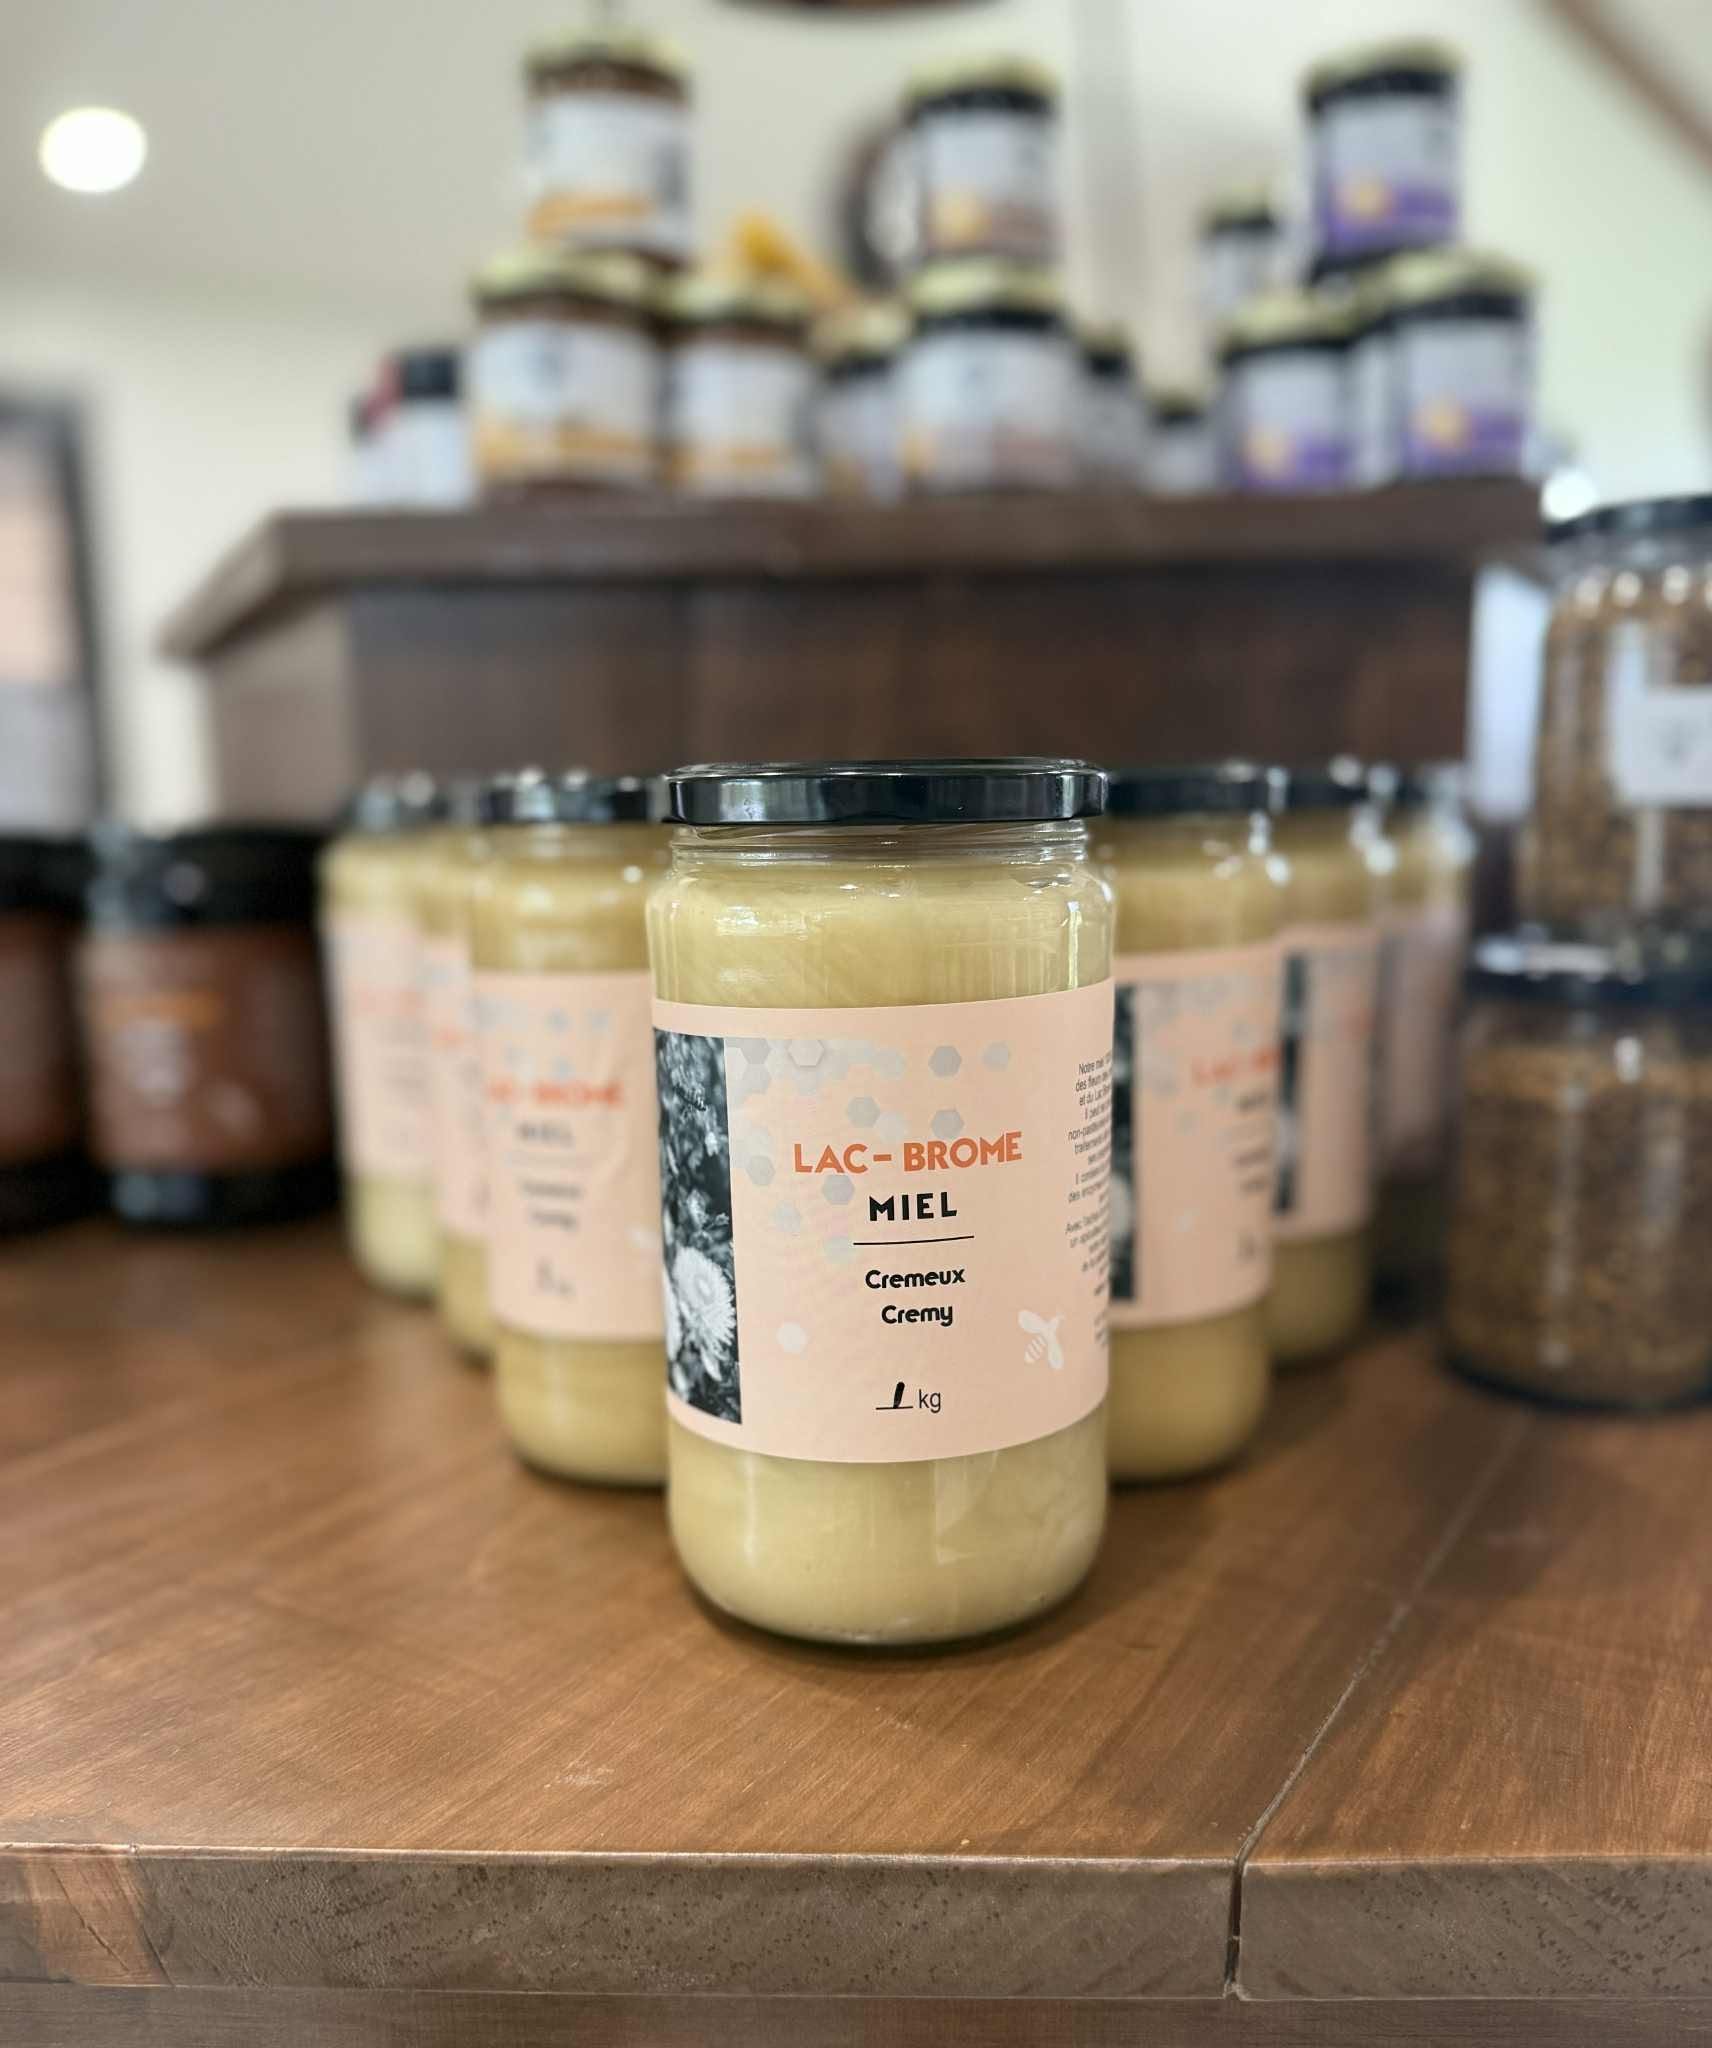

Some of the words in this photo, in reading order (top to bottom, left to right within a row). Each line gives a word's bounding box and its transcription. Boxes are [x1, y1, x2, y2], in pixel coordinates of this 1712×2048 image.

[1075, 1079, 1087, 1092] des
[904, 1132, 1022, 1172] BROME
[869, 1192, 957, 1222] MIEL
[865, 1268, 966, 1290] Cremeux
[881, 1304, 953, 1327] Cremy
[918, 1388, 942, 1414] kg
